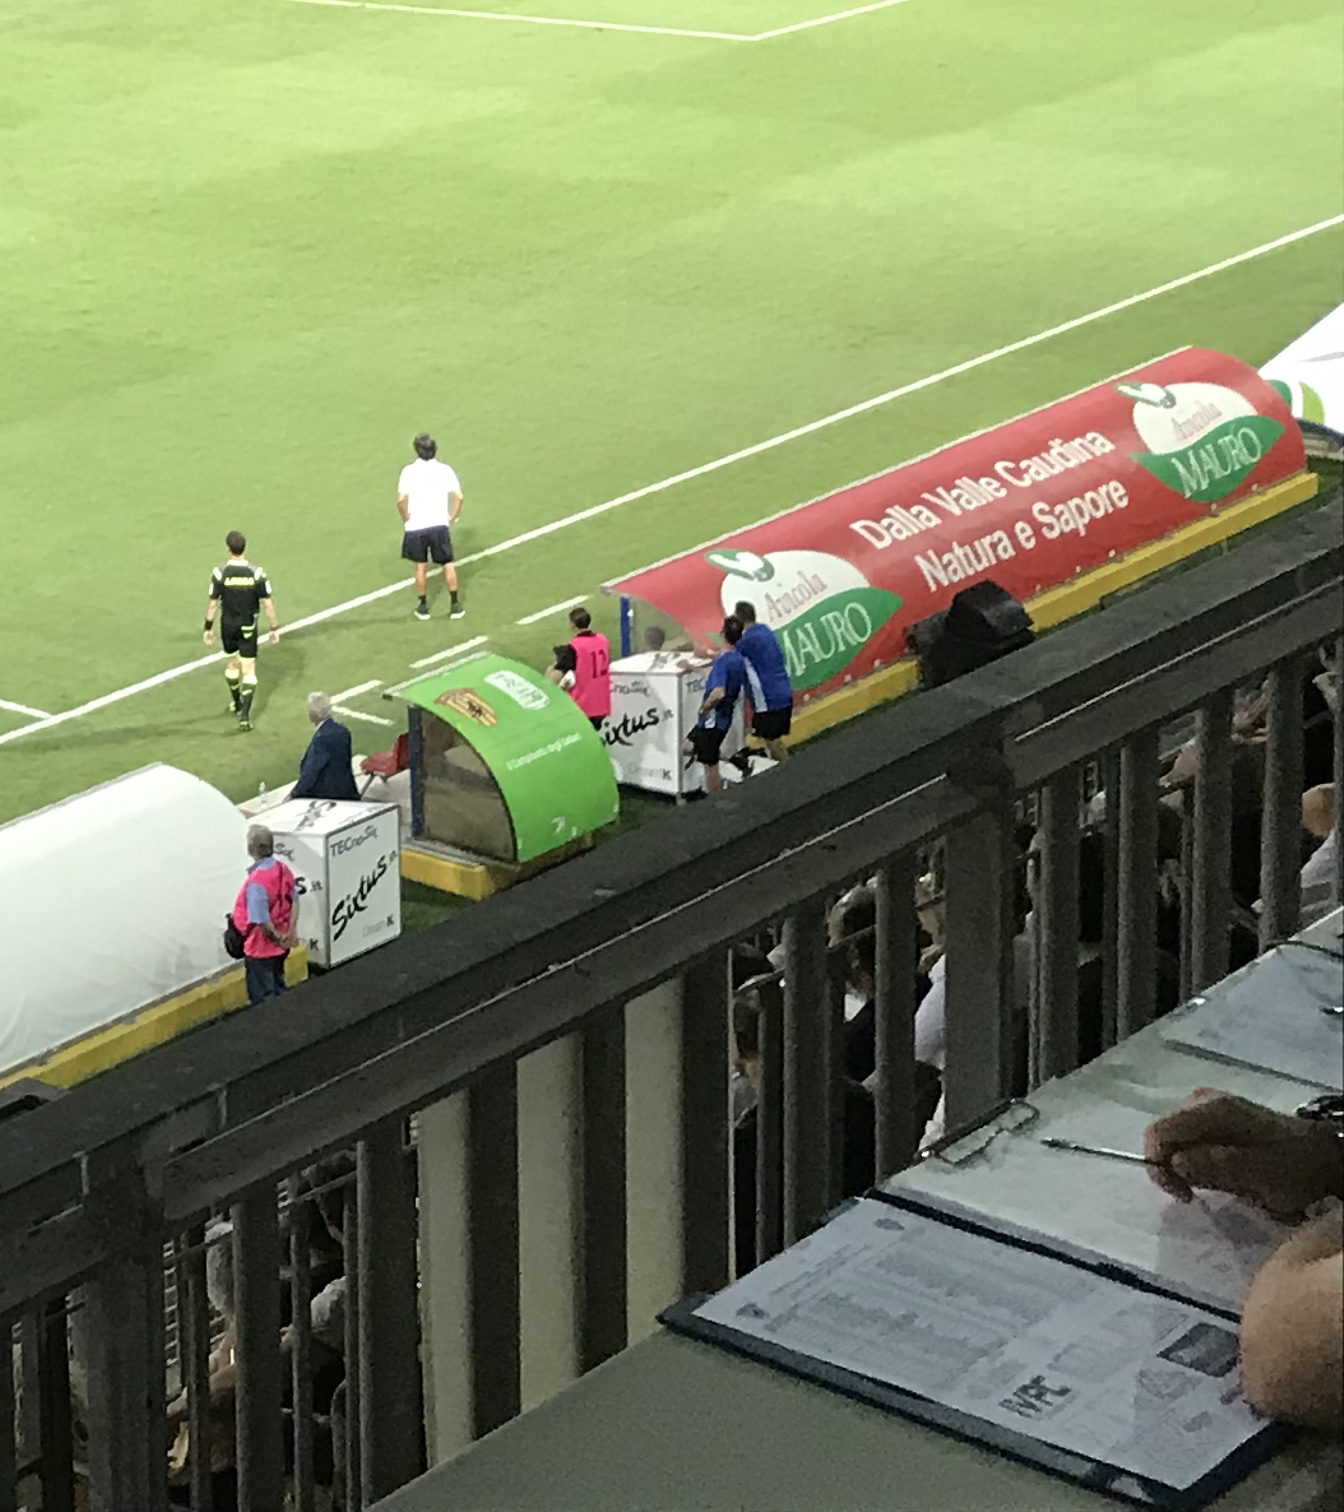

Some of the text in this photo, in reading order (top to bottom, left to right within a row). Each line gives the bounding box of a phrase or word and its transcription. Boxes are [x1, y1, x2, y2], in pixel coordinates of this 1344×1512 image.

[849, 431, 1116, 550] Dalla Valle Caudina
[1170, 427, 1263, 499] MAURO
[914, 480, 1129, 592] Natura e Sapore
[782, 602, 873, 677] MAURO
[600, 707, 659, 747] ixtus
[332, 854, 387, 942] Sixtus
